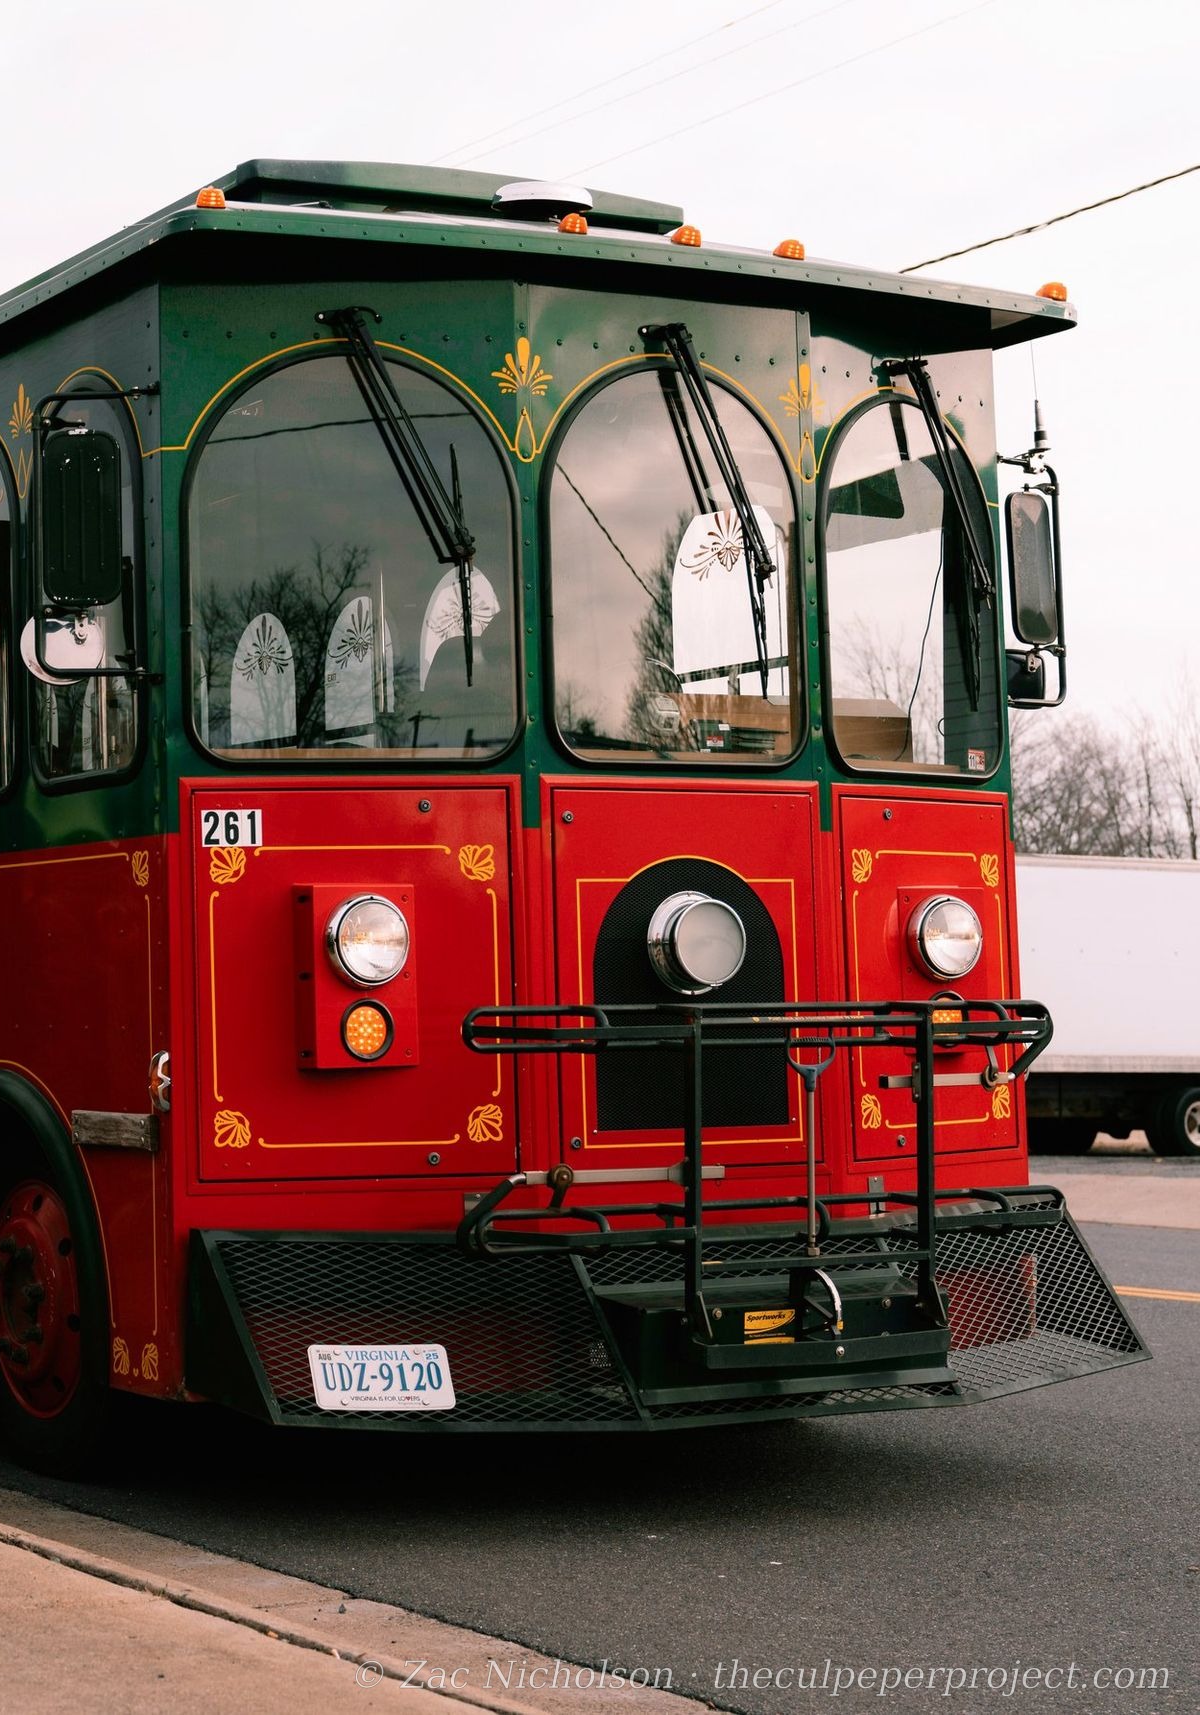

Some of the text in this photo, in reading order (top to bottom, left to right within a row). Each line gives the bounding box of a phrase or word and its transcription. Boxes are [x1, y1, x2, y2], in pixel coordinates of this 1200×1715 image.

[204, 811, 256, 845] 261
[747, 1313, 786, 1322] Sportworks
[318, 1353, 332, 1361] AUG
[345, 1350, 410, 1361] VIRGINIA
[321, 1361, 442, 1391] UDZ-9120
